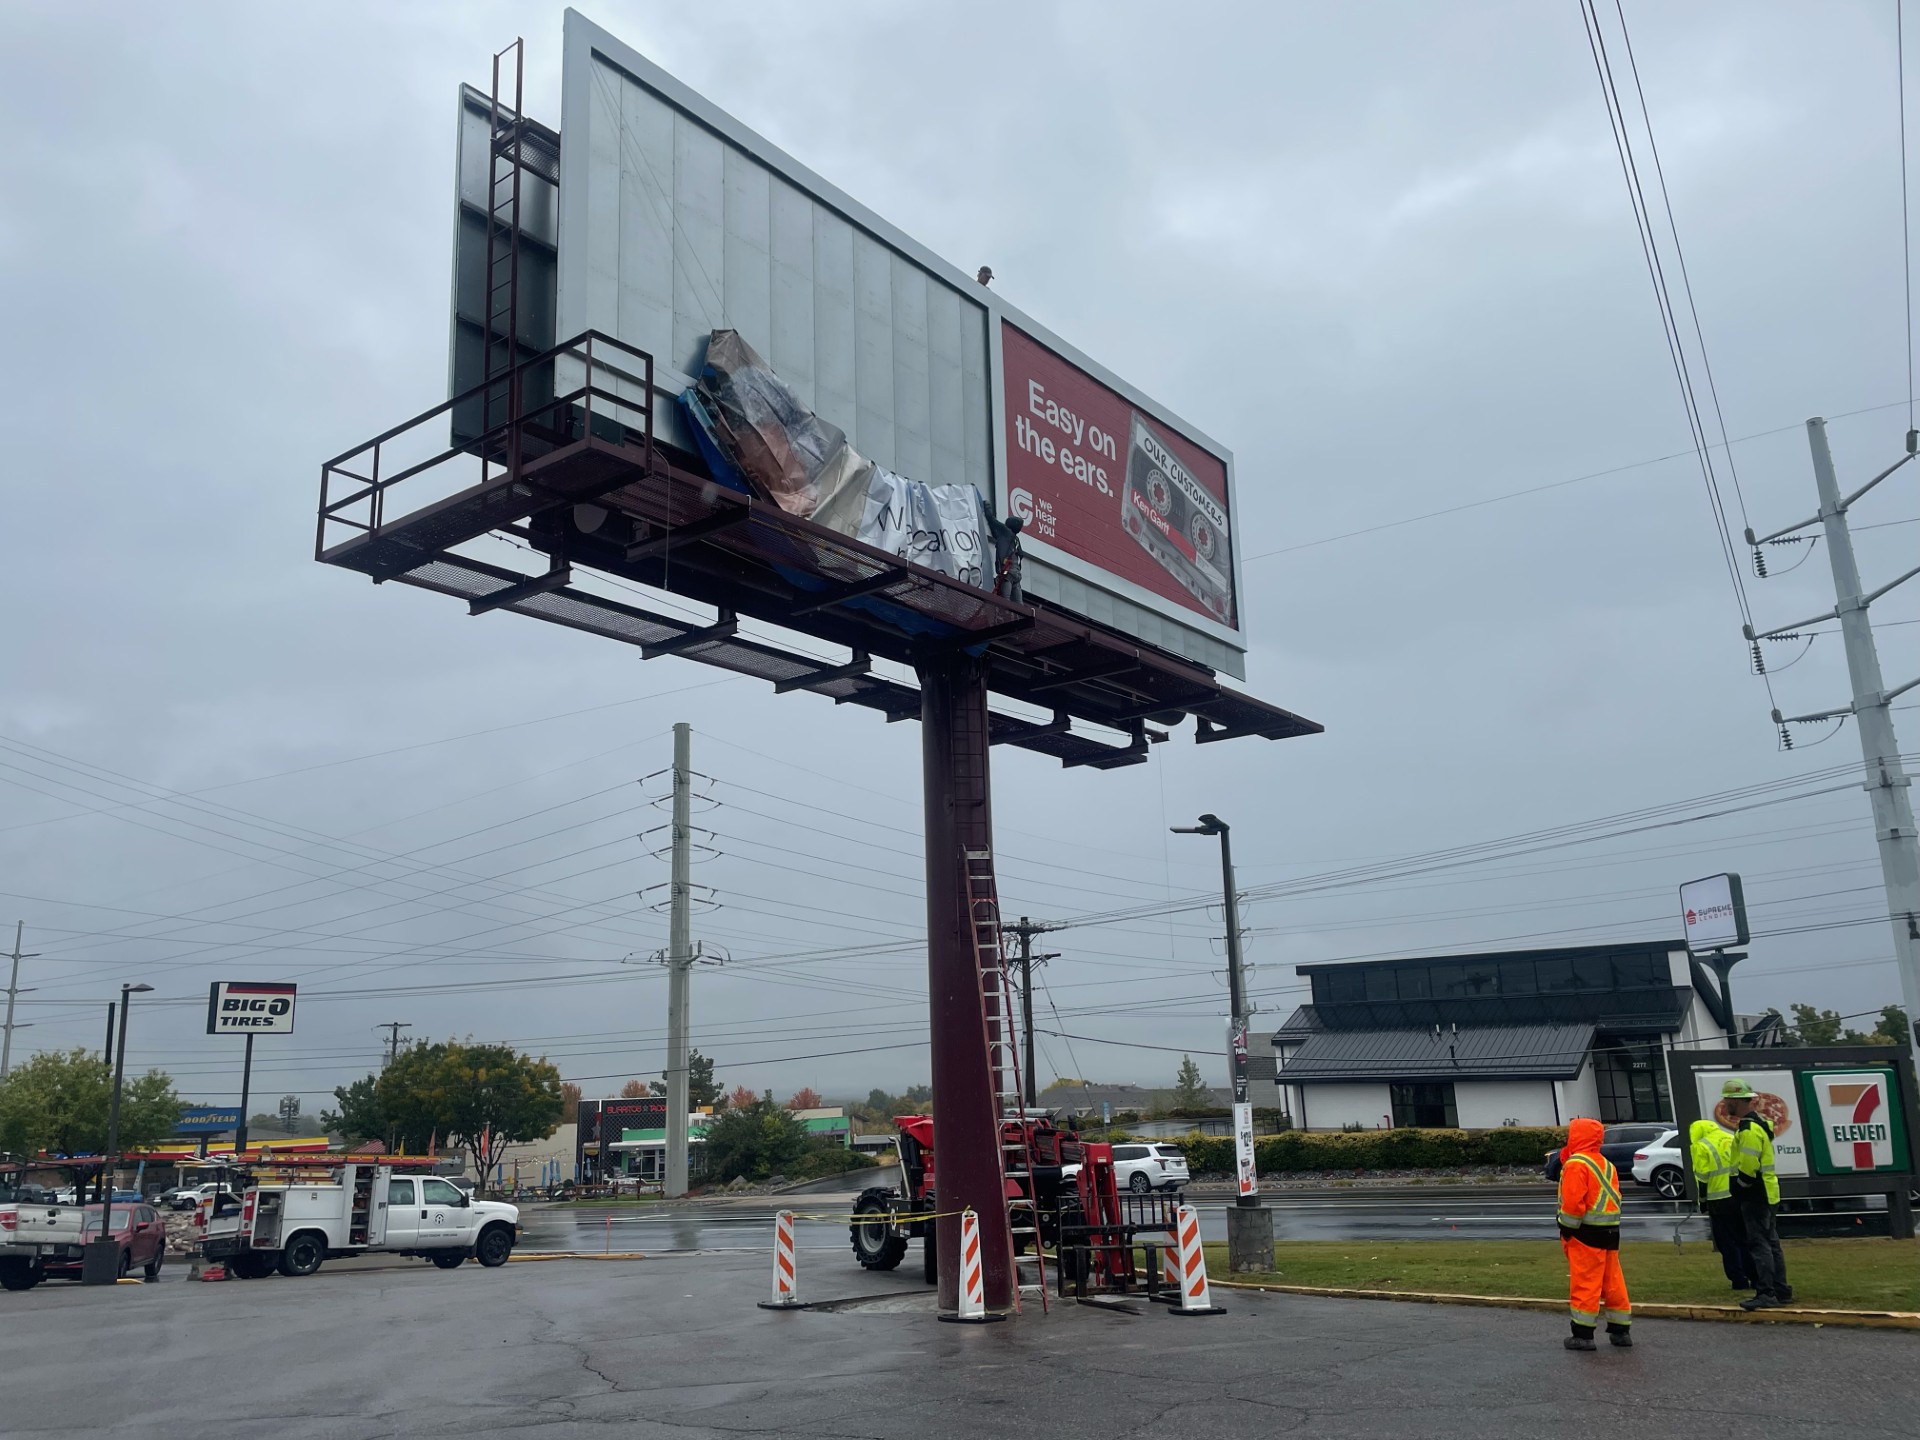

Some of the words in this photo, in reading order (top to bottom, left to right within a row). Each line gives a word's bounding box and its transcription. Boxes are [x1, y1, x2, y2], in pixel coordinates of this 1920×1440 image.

[1029, 379, 1084, 446] Easy
[1089, 426, 1116, 460] on
[1016, 415, 1055, 464] the
[1060, 448, 1113, 497] ears.
[1144, 437, 1168, 469] OUR
[1171, 464, 1223, 526] CUSTOMERS
[1038, 498, 1053, 513] we
[1133, 491, 1150, 515] Ken
[1150, 510, 1169, 535] Garff
[1035, 504, 1056, 525] hear
[1038, 523, 1055, 538] you
[1698, 904, 1732, 916] SUPREME
[1699, 911, 1733, 922] LENDING
[222, 999, 267, 1012] BIG
[268, 998, 290, 1015] O
[220, 1016, 274, 1026] TIRES
[180, 1113, 236, 1124] OODYEAR
[1827, 1082, 1880, 1169] 7
[1777, 1144, 1802, 1155] Pizza
